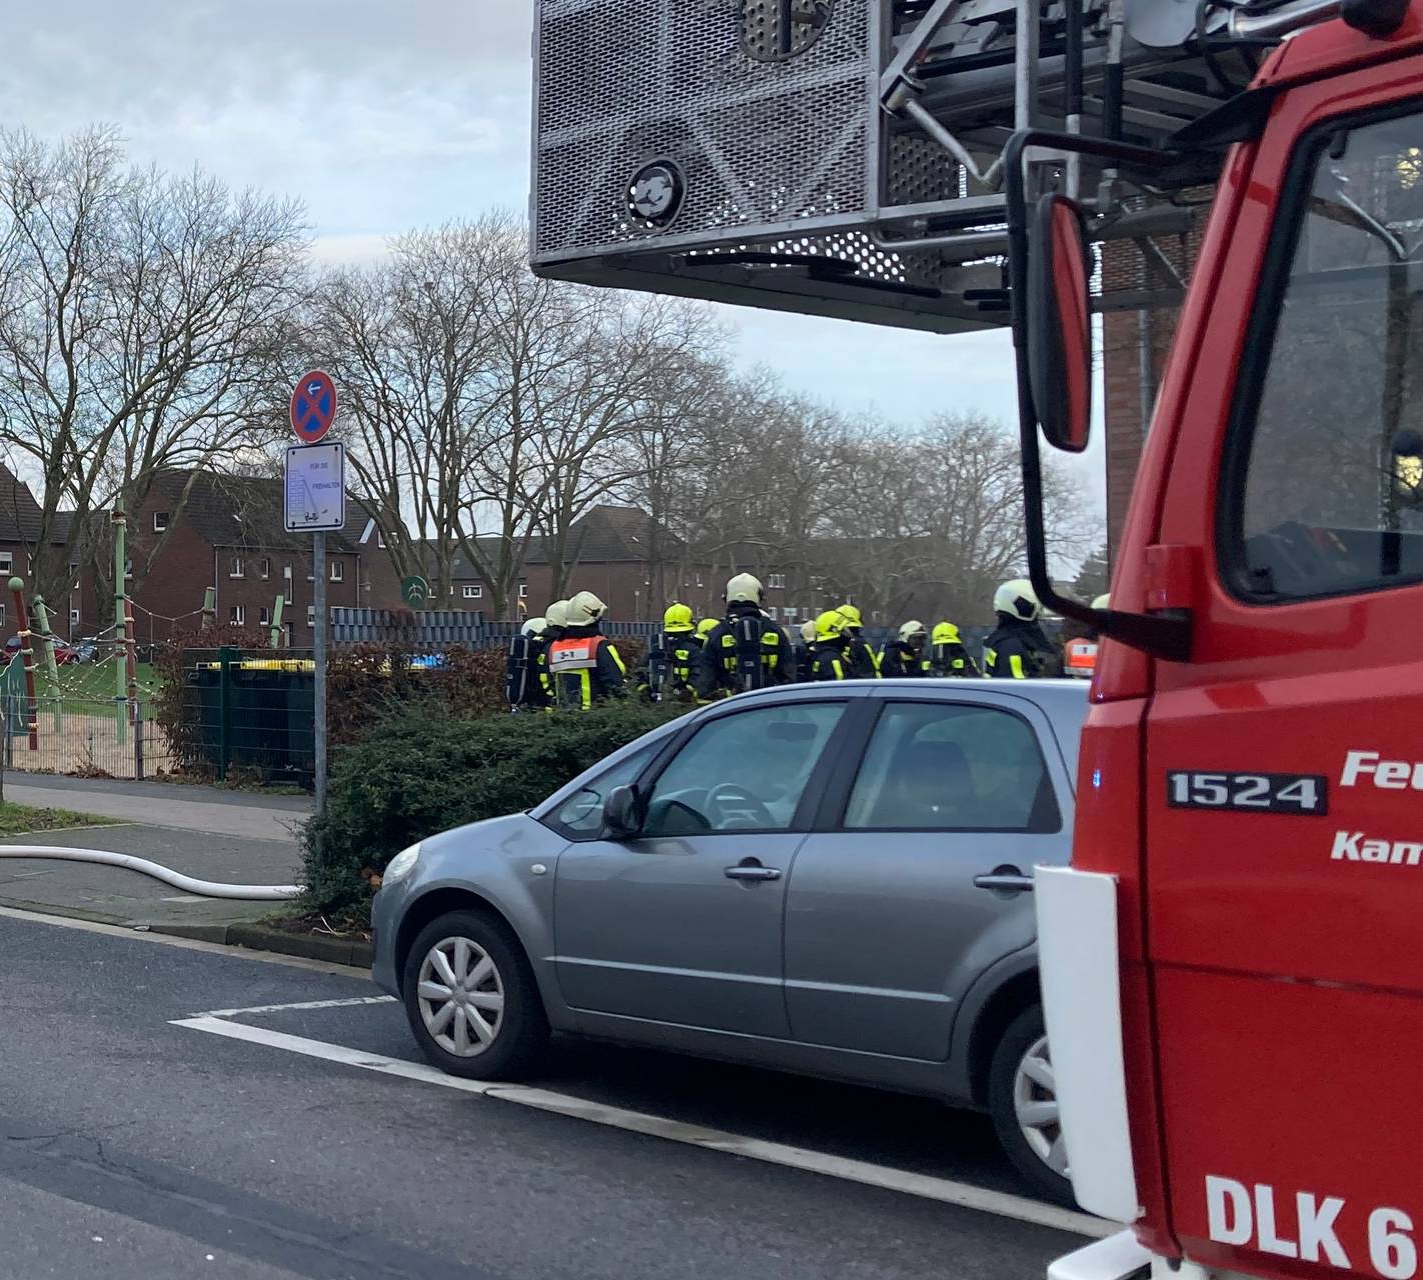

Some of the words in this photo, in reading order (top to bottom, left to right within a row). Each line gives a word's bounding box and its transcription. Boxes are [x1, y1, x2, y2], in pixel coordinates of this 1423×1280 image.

[1171, 774, 1319, 809] 1524
[1205, 1175, 1352, 1270] DLK
[1367, 1206, 1418, 1280] 6
